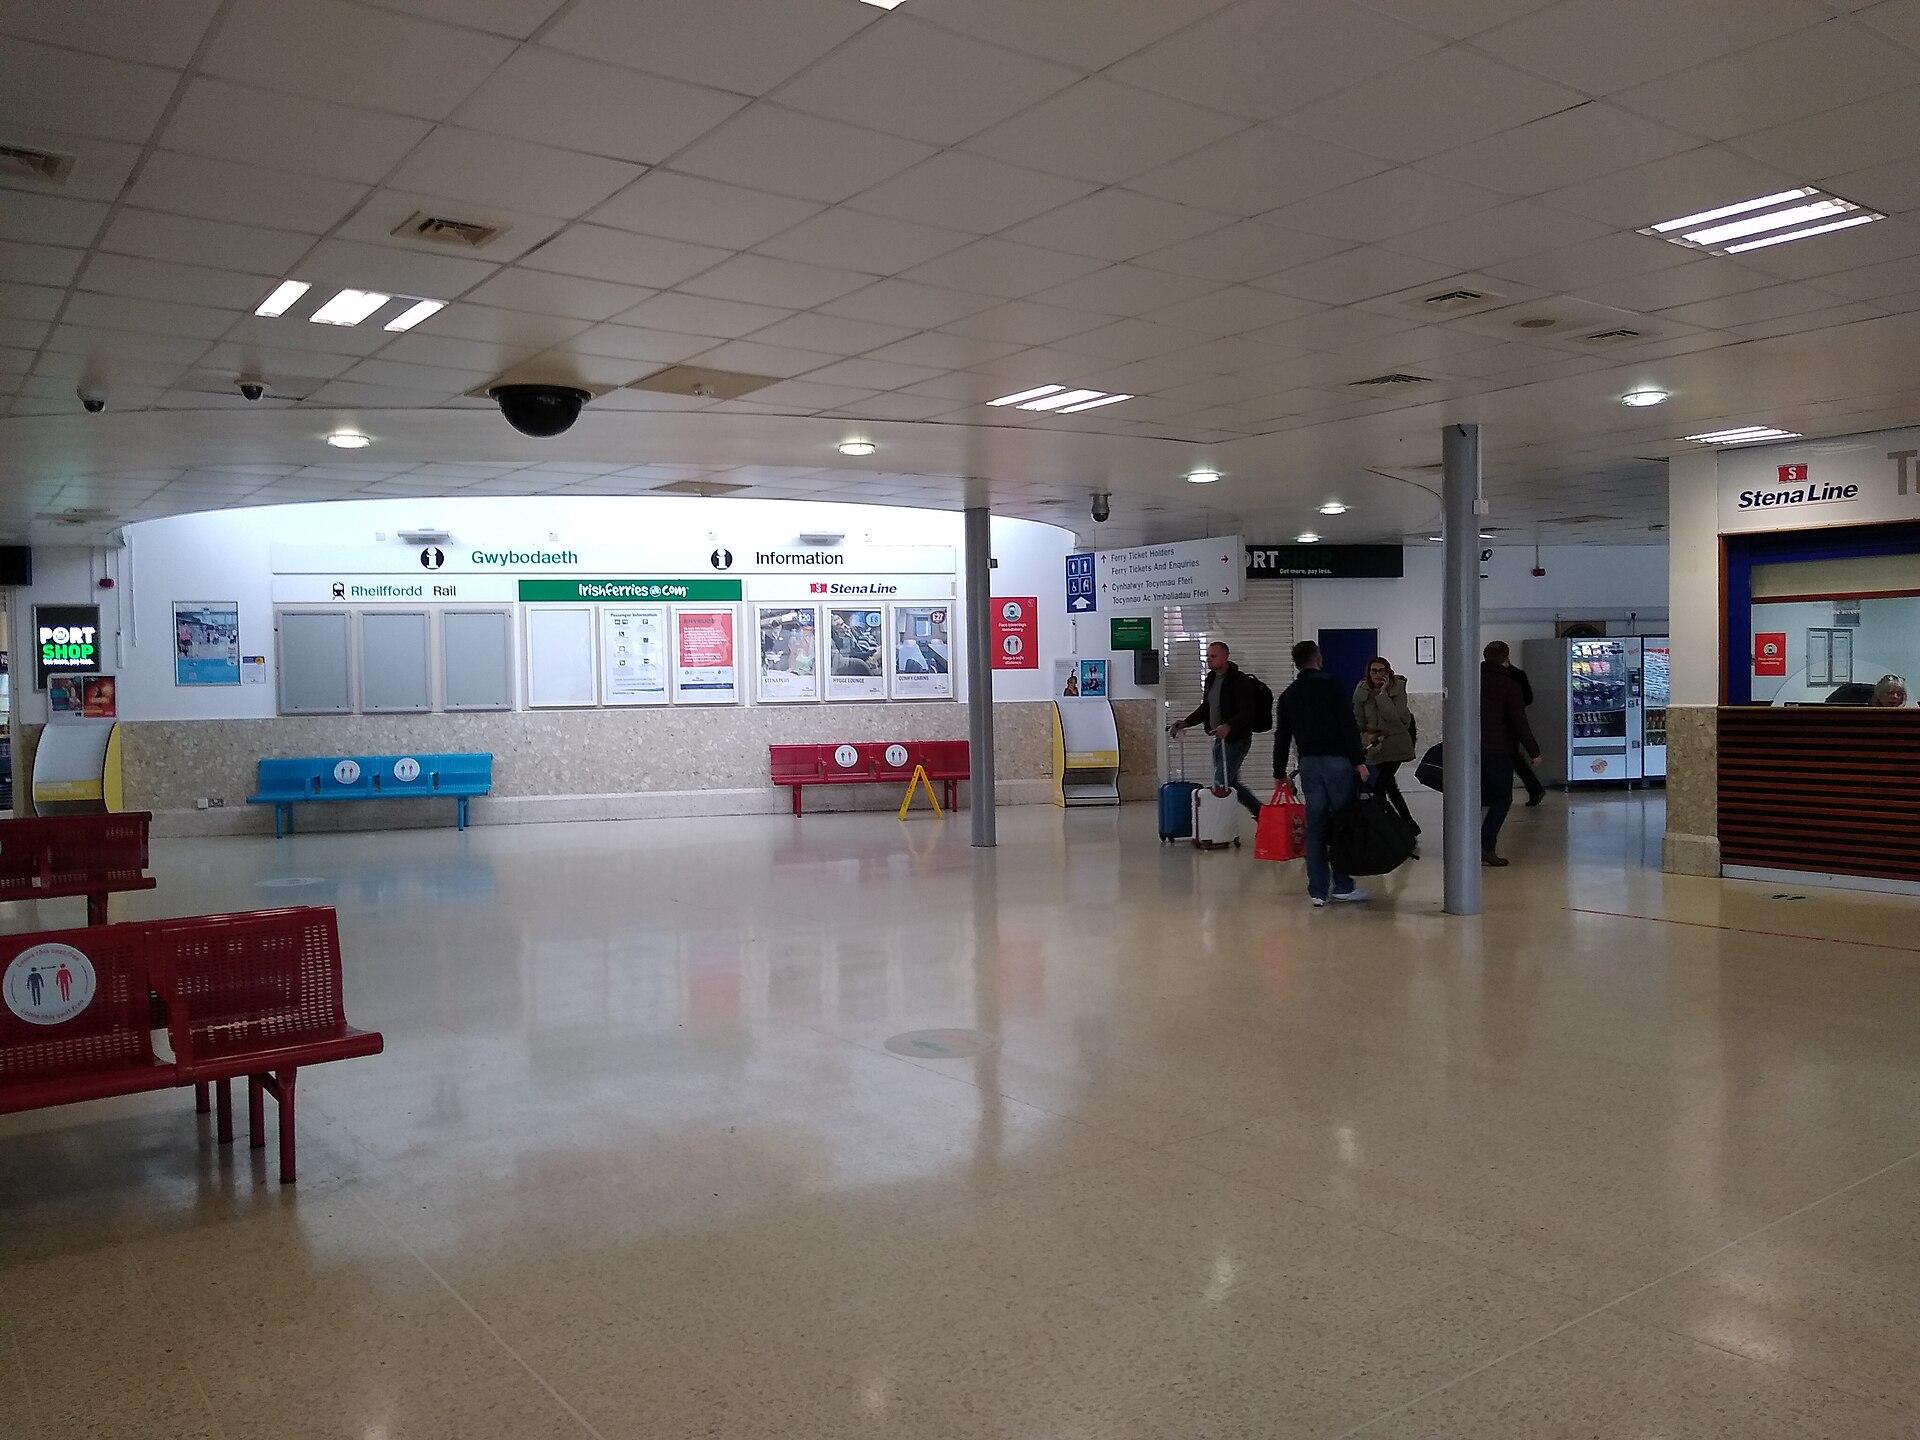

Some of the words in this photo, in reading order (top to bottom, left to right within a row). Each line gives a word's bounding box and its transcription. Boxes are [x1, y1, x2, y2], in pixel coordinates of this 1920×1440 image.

[1887, 450, 1920, 495] T
[1738, 489, 1804, 508] Stena
[1806, 482, 1858, 502] Line
[471, 550, 578, 566] Gwybodaeth
[756, 552, 844, 565] Information
[1111, 554, 1127, 563] Ferry
[1129, 551, 1148, 560] Ticket
[1149, 548, 1175, 558] Holders
[1111, 567, 1127, 575] Ferry
[1129, 564, 1152, 573] Tickets
[1154, 562, 1167, 570] And
[1169, 559, 1200, 569] Enquiries
[351, 585, 423, 597] Rheilffordd
[433, 585, 457, 597] Rail
[830, 583, 868, 594] Stena
[869, 583, 898, 594] Line
[1112, 582, 1144, 592] Cynhalwyr
[1146, 579, 1176, 589] Tocynnau
[1177, 576, 1193, 585] Fferi
[1113, 596, 1141, 606] Tocynnau
[1143, 594, 1151, 602] Ac
[1152, 591, 1191, 602] Ymholiadau
[1193, 589, 1209, 598] Fferi
[40, 627, 96, 644] PORT
[43, 644, 93, 659] SHOP
